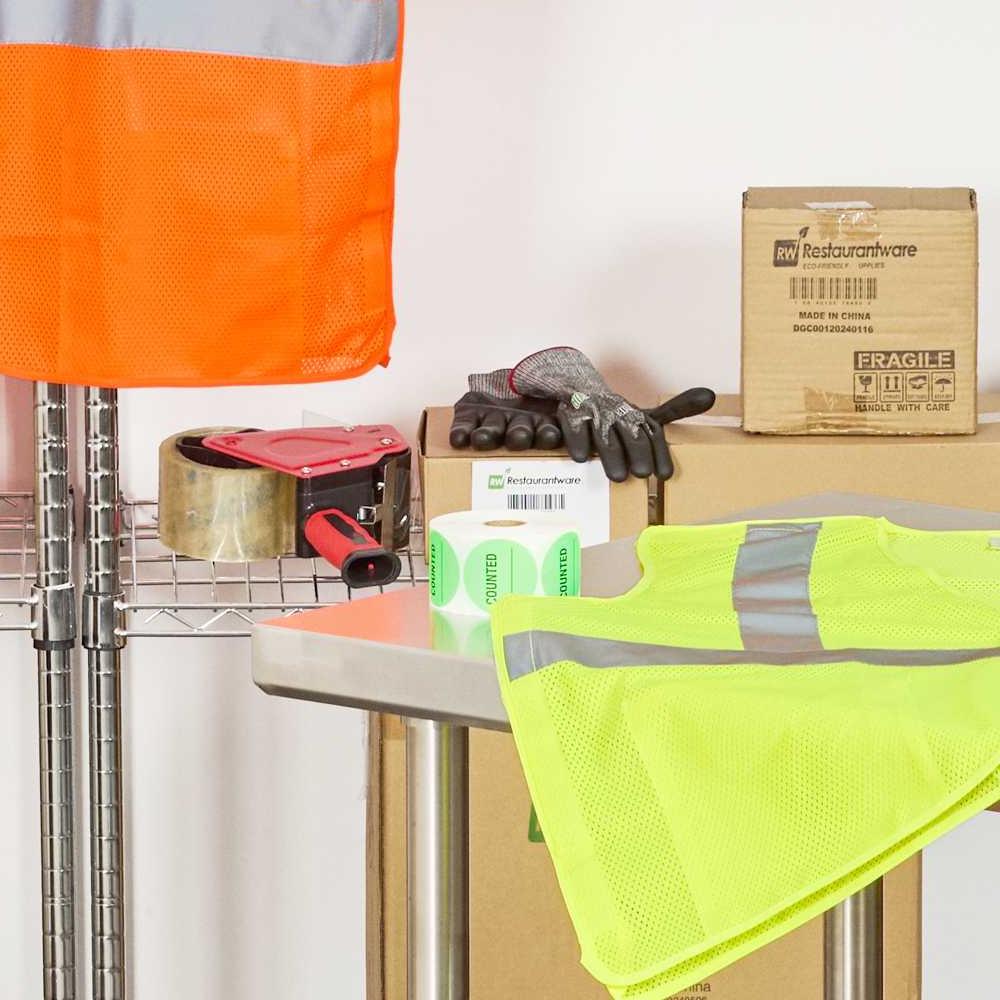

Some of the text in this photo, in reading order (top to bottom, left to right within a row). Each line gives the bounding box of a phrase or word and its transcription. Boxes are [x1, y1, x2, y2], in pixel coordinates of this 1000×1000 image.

[776, 241, 918, 261] RW Restaurantware
[799, 312, 825, 320] MADE
[828, 312, 838, 320] IN
[858, 352, 952, 369] FRAGILE
[855, 403, 950, 412] HANDLE WITH CARE
[507, 475, 581, 485] Restaurantware
[485, 553, 497, 605] COUNTED
